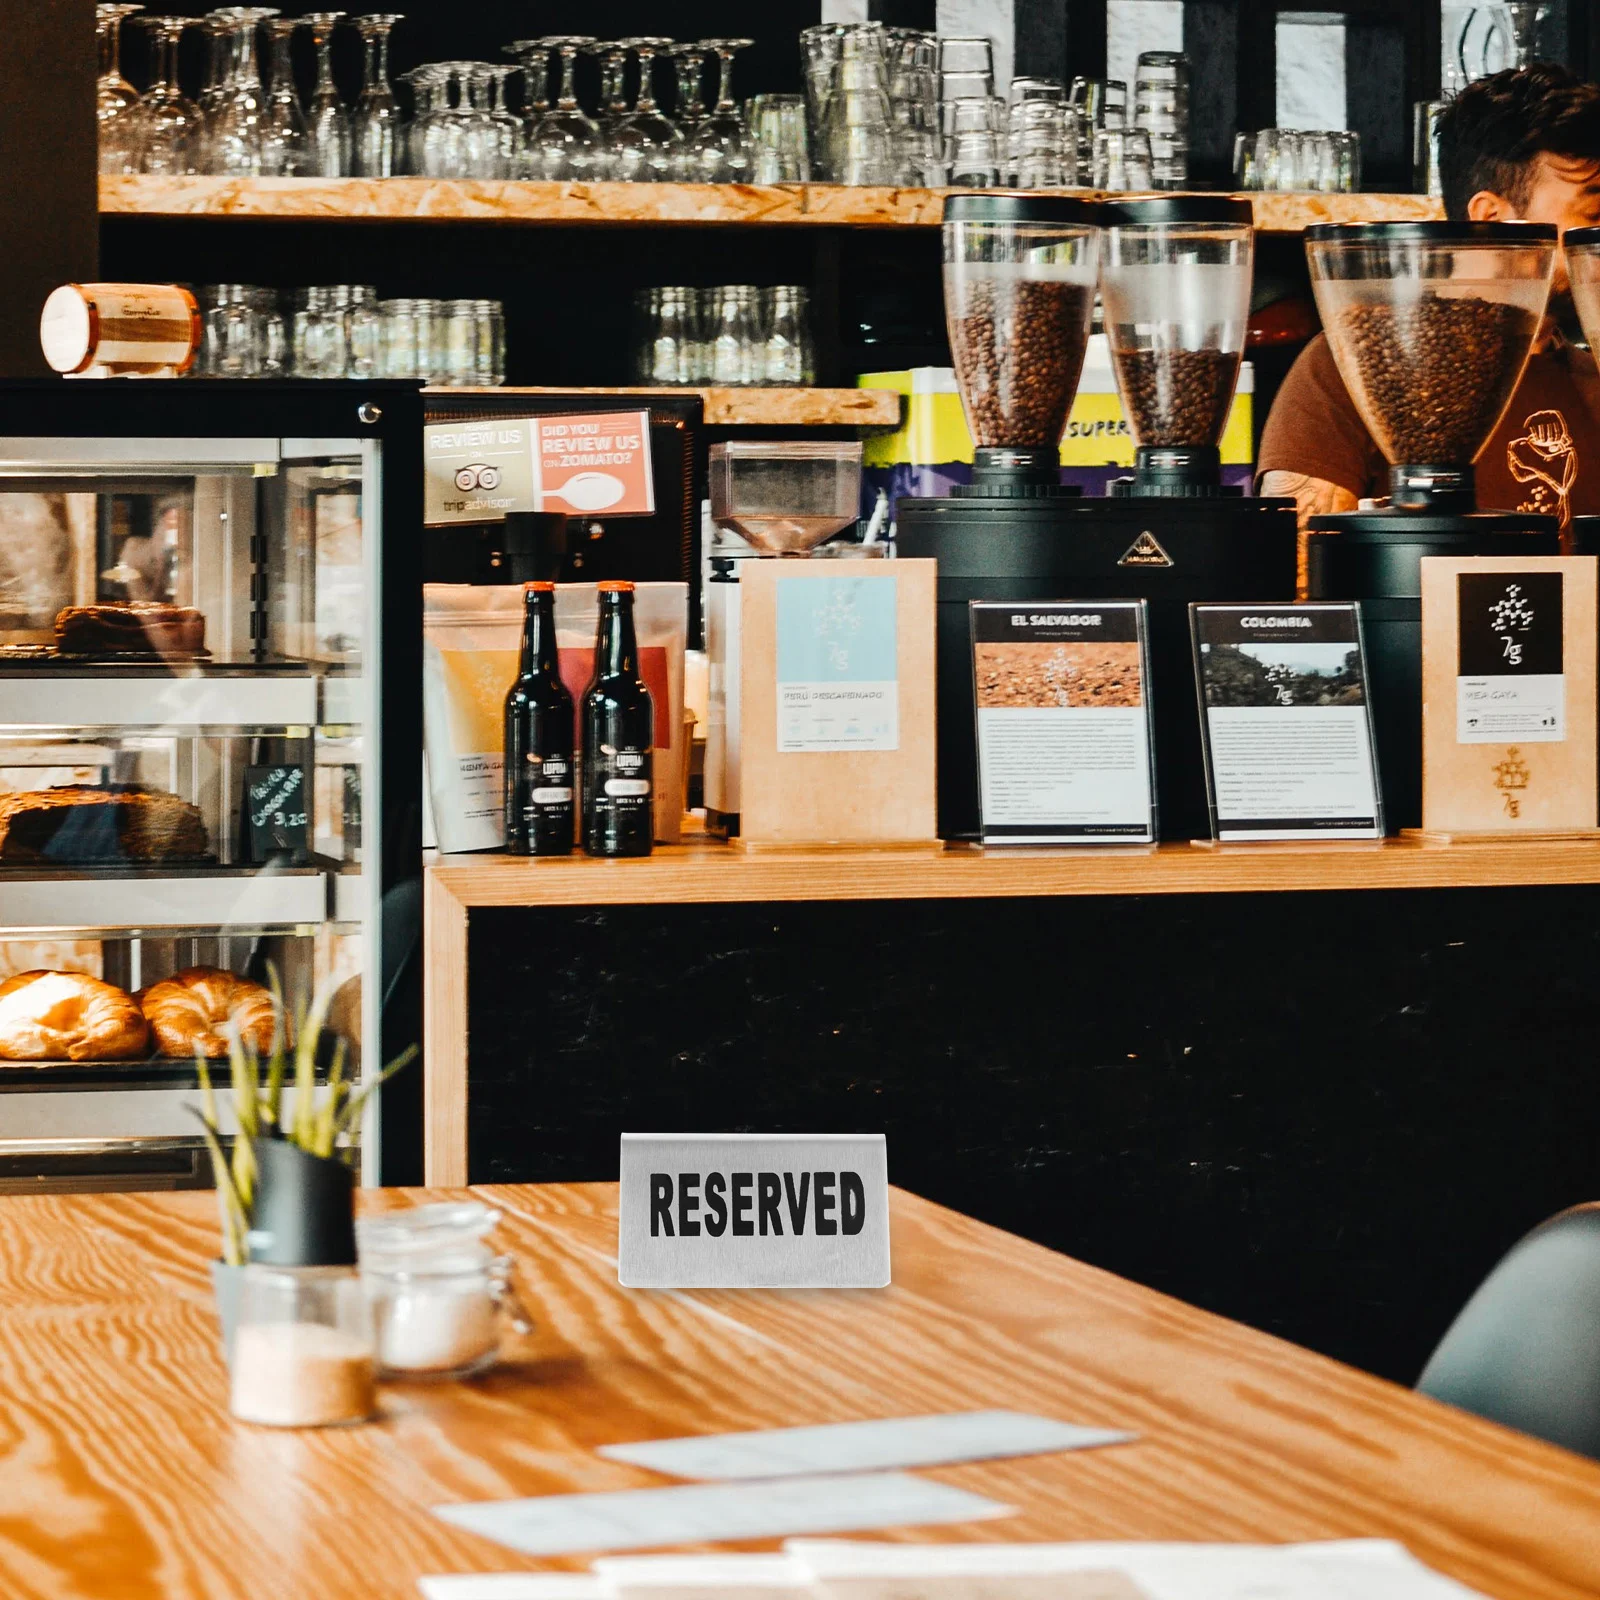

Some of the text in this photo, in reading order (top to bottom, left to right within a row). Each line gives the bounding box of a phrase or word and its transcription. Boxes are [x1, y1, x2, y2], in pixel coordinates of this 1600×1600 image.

[542, 423, 600, 437] DID YOU
[1068, 420, 1131, 438] SUPER
[430, 430, 522, 449] REVIEW US
[542, 435, 640, 453] REVIEW US
[559, 452, 633, 467] ZOMATO?
[1011, 615, 1102, 626] EL SALVADOR
[1240, 616, 1313, 628] COLOMBIA
[650, 1171, 865, 1237] RESERVED
